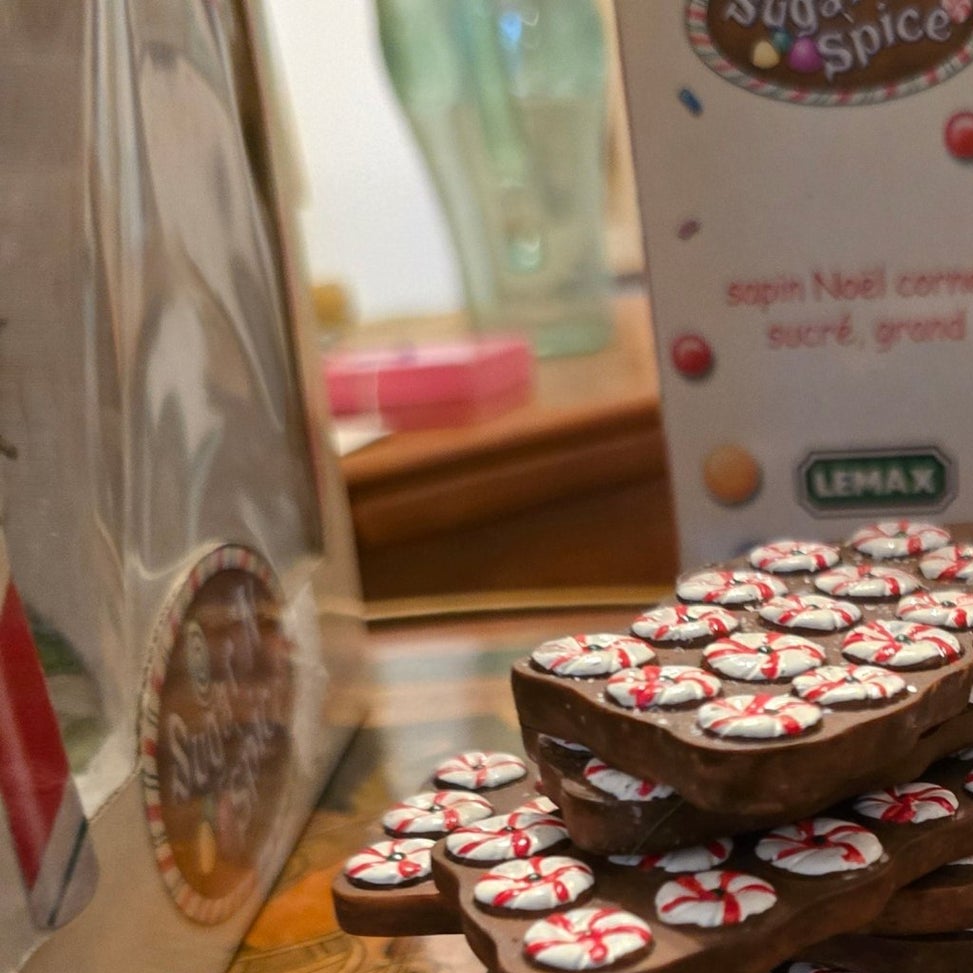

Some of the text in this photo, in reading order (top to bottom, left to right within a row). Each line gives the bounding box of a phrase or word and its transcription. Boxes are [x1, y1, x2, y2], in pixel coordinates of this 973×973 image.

[726, 277, 805, 312] sapin
[874, 307, 967, 353] grand
[813, 465, 938, 498] LEMAX
